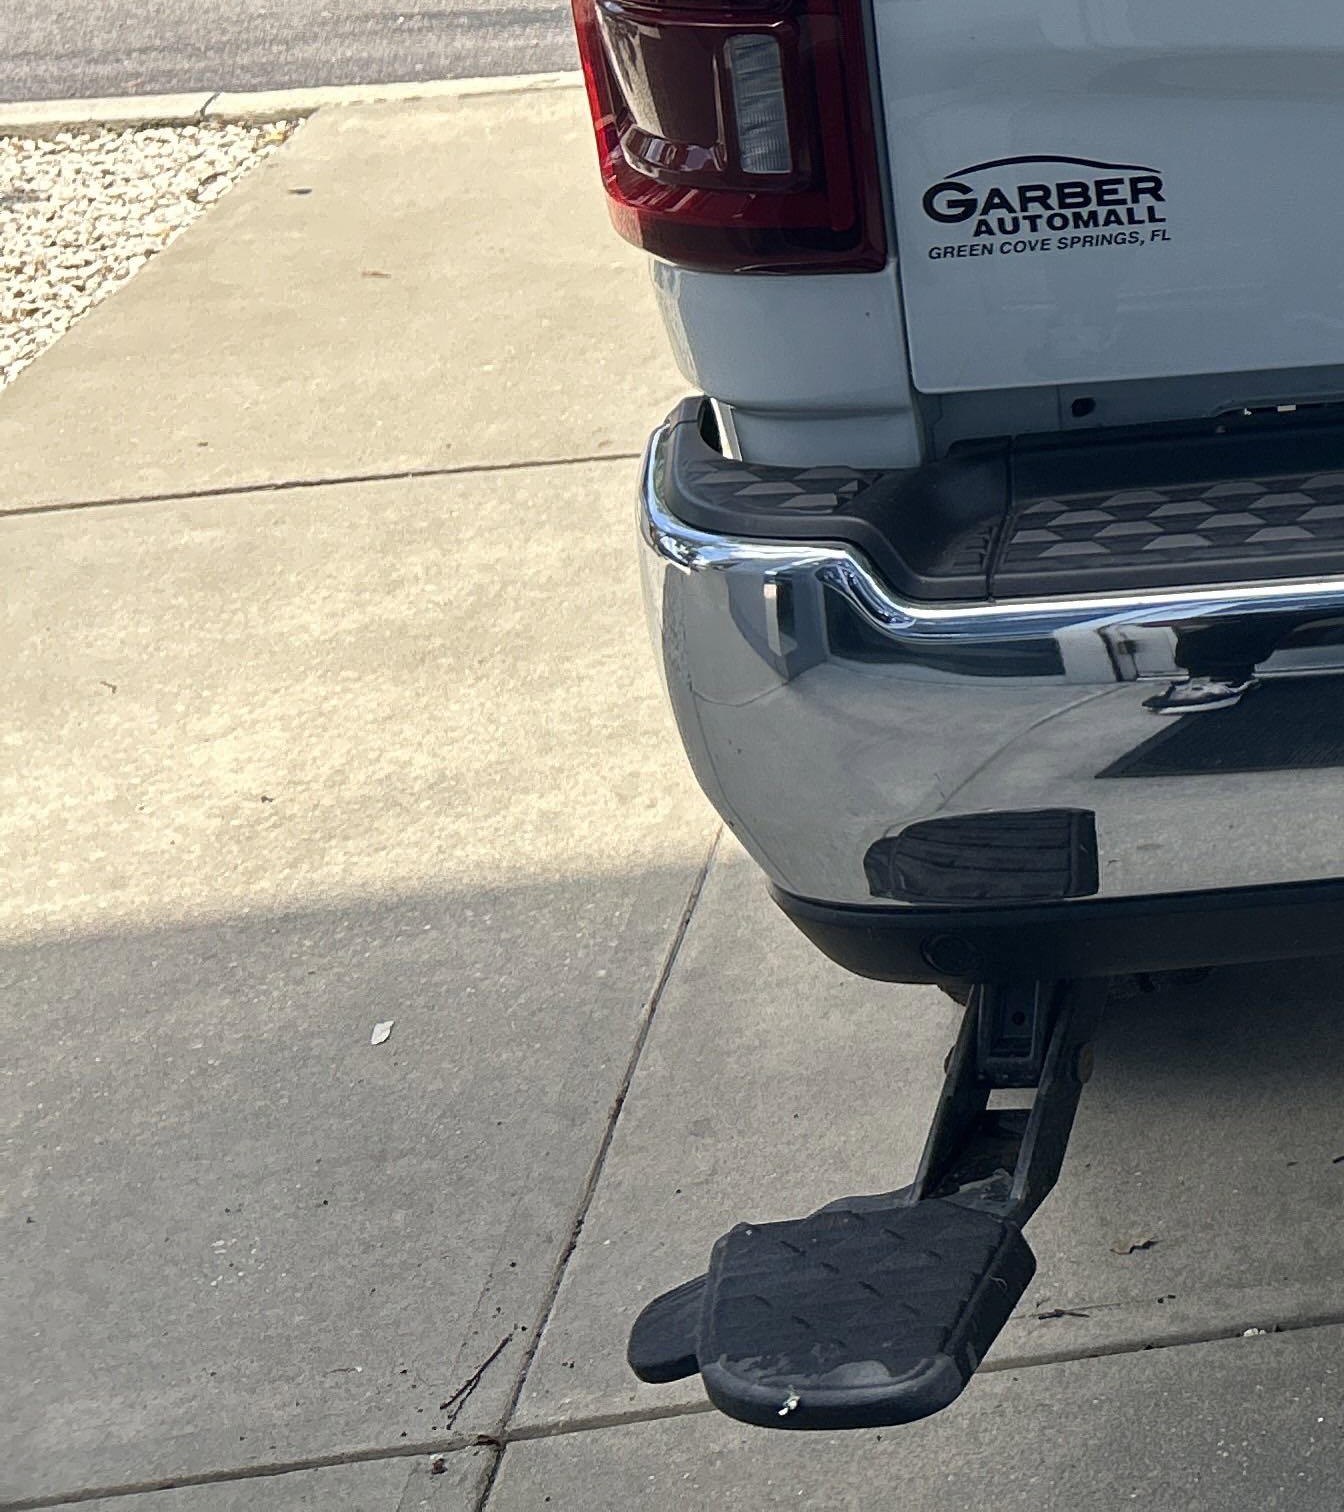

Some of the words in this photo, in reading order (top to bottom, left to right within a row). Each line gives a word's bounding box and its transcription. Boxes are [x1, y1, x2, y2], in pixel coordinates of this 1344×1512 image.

[922, 175, 1167, 224] GARBER
[973, 204, 1168, 237] AUTOMALL
[928, 241, 995, 260] GREEN
[999, 237, 1052, 255] COVE
[1057, 230, 1146, 250] SPRINGS,
[1150, 228, 1172, 243] FL
